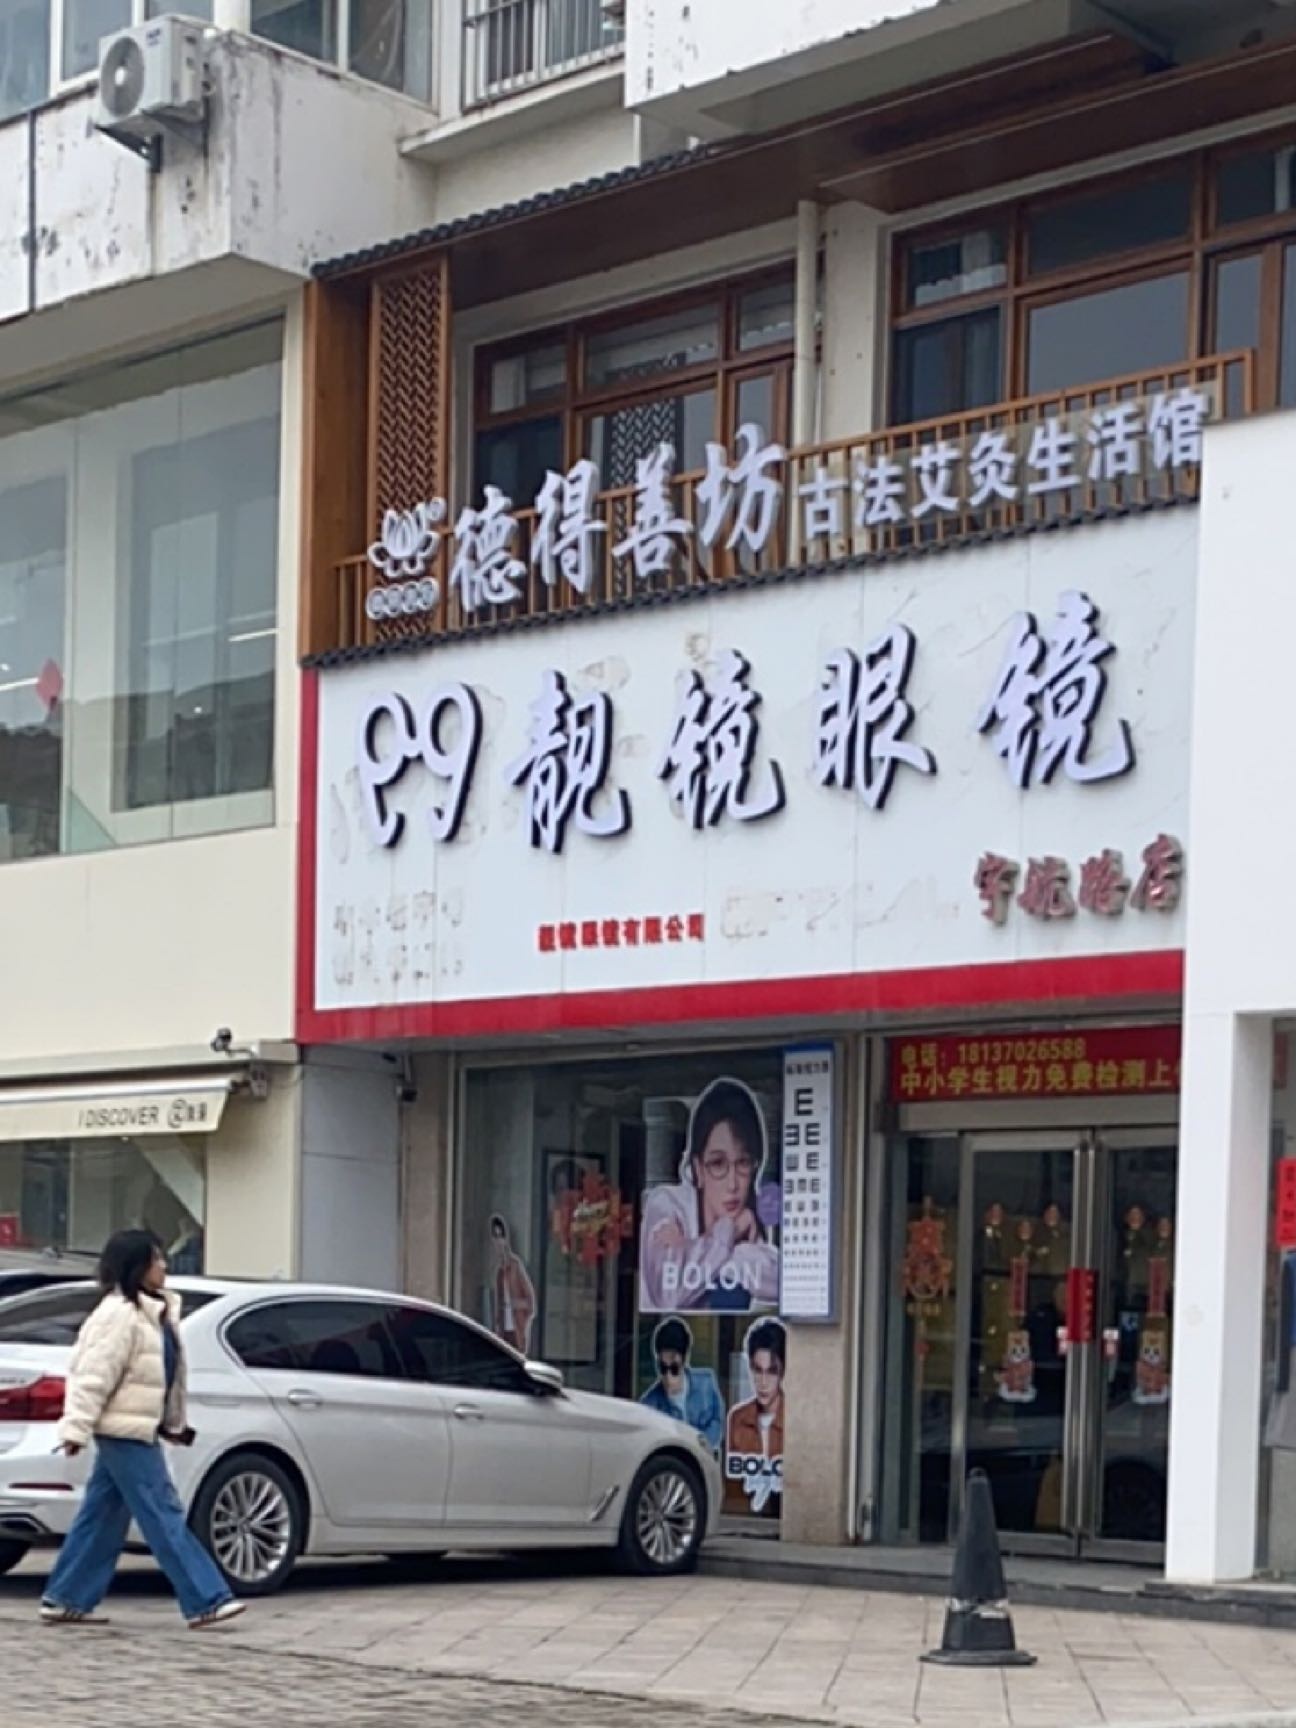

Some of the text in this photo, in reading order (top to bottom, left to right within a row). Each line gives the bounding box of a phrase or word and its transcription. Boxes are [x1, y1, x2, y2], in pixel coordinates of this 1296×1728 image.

[451, 390, 1208, 611] 德得善坊 古法艾灸生活馆
[974, 833, 1186, 927] 宇航路店
[901, 1058, 1181, 1096] 中小学生视力免费检测上
[661, 1260, 763, 1291] BOLON
